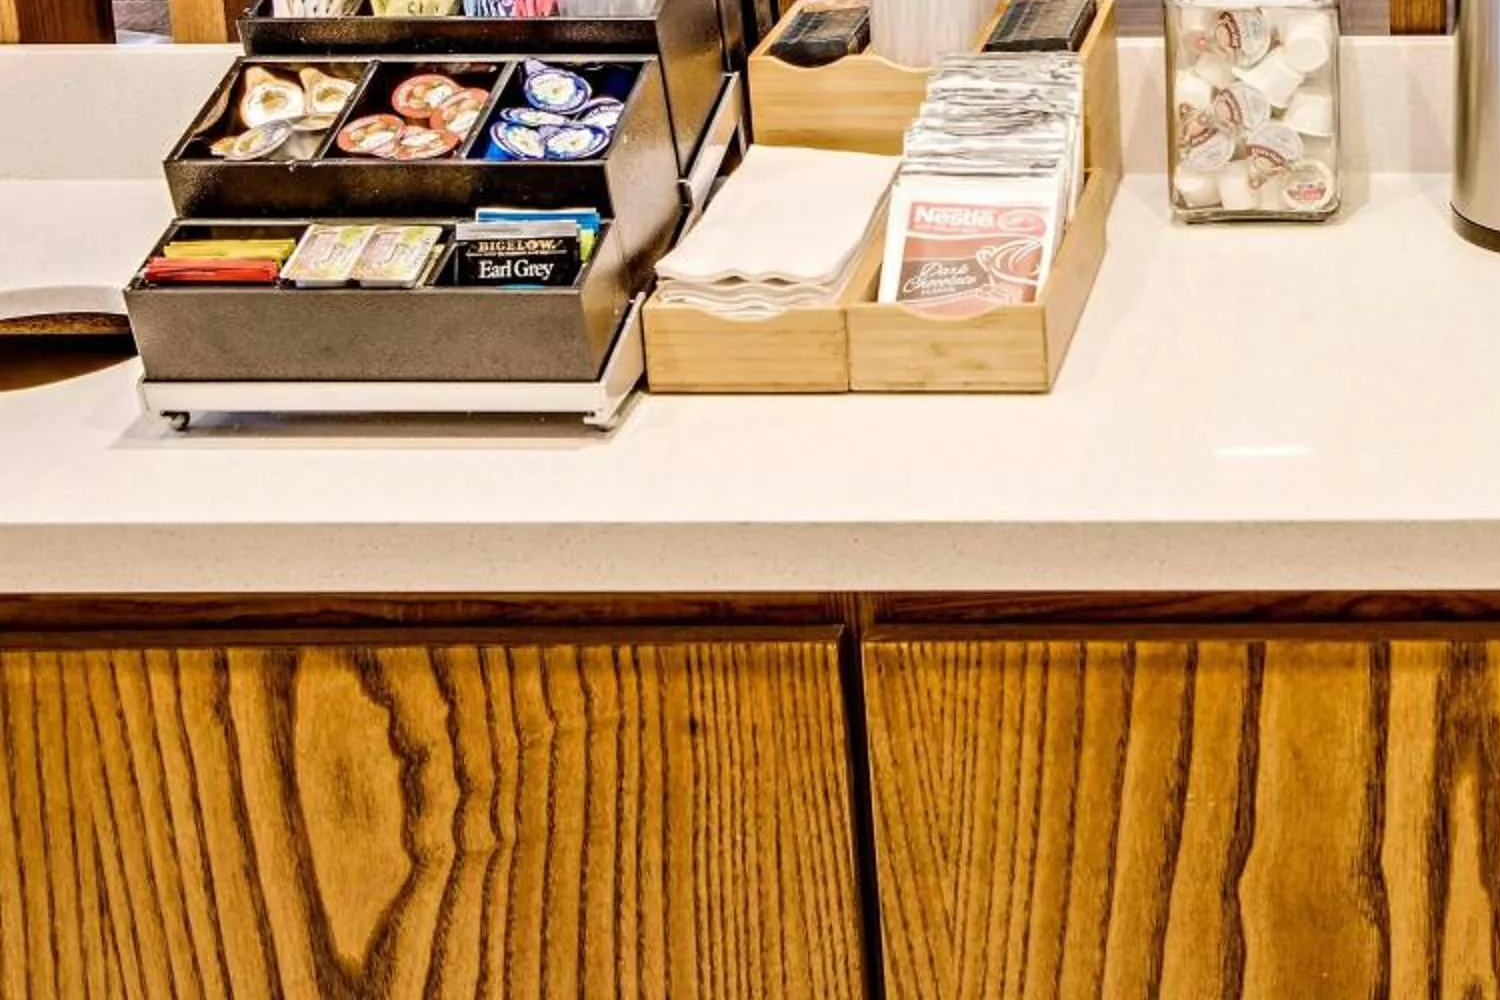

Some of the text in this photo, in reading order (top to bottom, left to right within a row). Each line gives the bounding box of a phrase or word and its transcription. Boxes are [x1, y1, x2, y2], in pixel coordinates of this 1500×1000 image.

[478, 240, 555, 252] BIGELOW
[479, 259, 555, 281] Earl Grey
